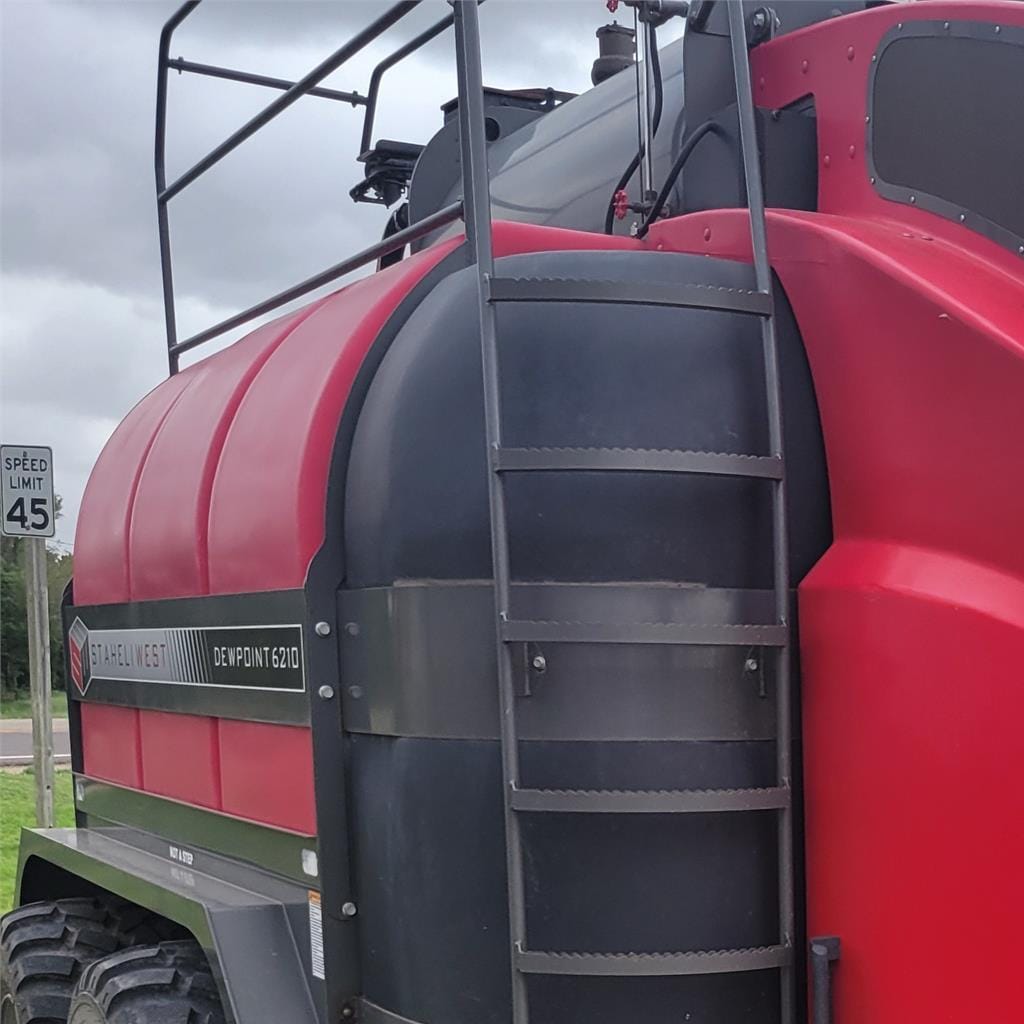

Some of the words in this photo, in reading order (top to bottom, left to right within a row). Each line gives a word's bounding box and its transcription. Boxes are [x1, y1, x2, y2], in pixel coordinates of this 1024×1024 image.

[5, 457, 48, 472] SPEED
[10, 476, 43, 490] LIMIT
[6, 497, 49, 530] 45
[213, 646, 270, 668] DEWPOINT
[272, 646, 299, 669] 6210
